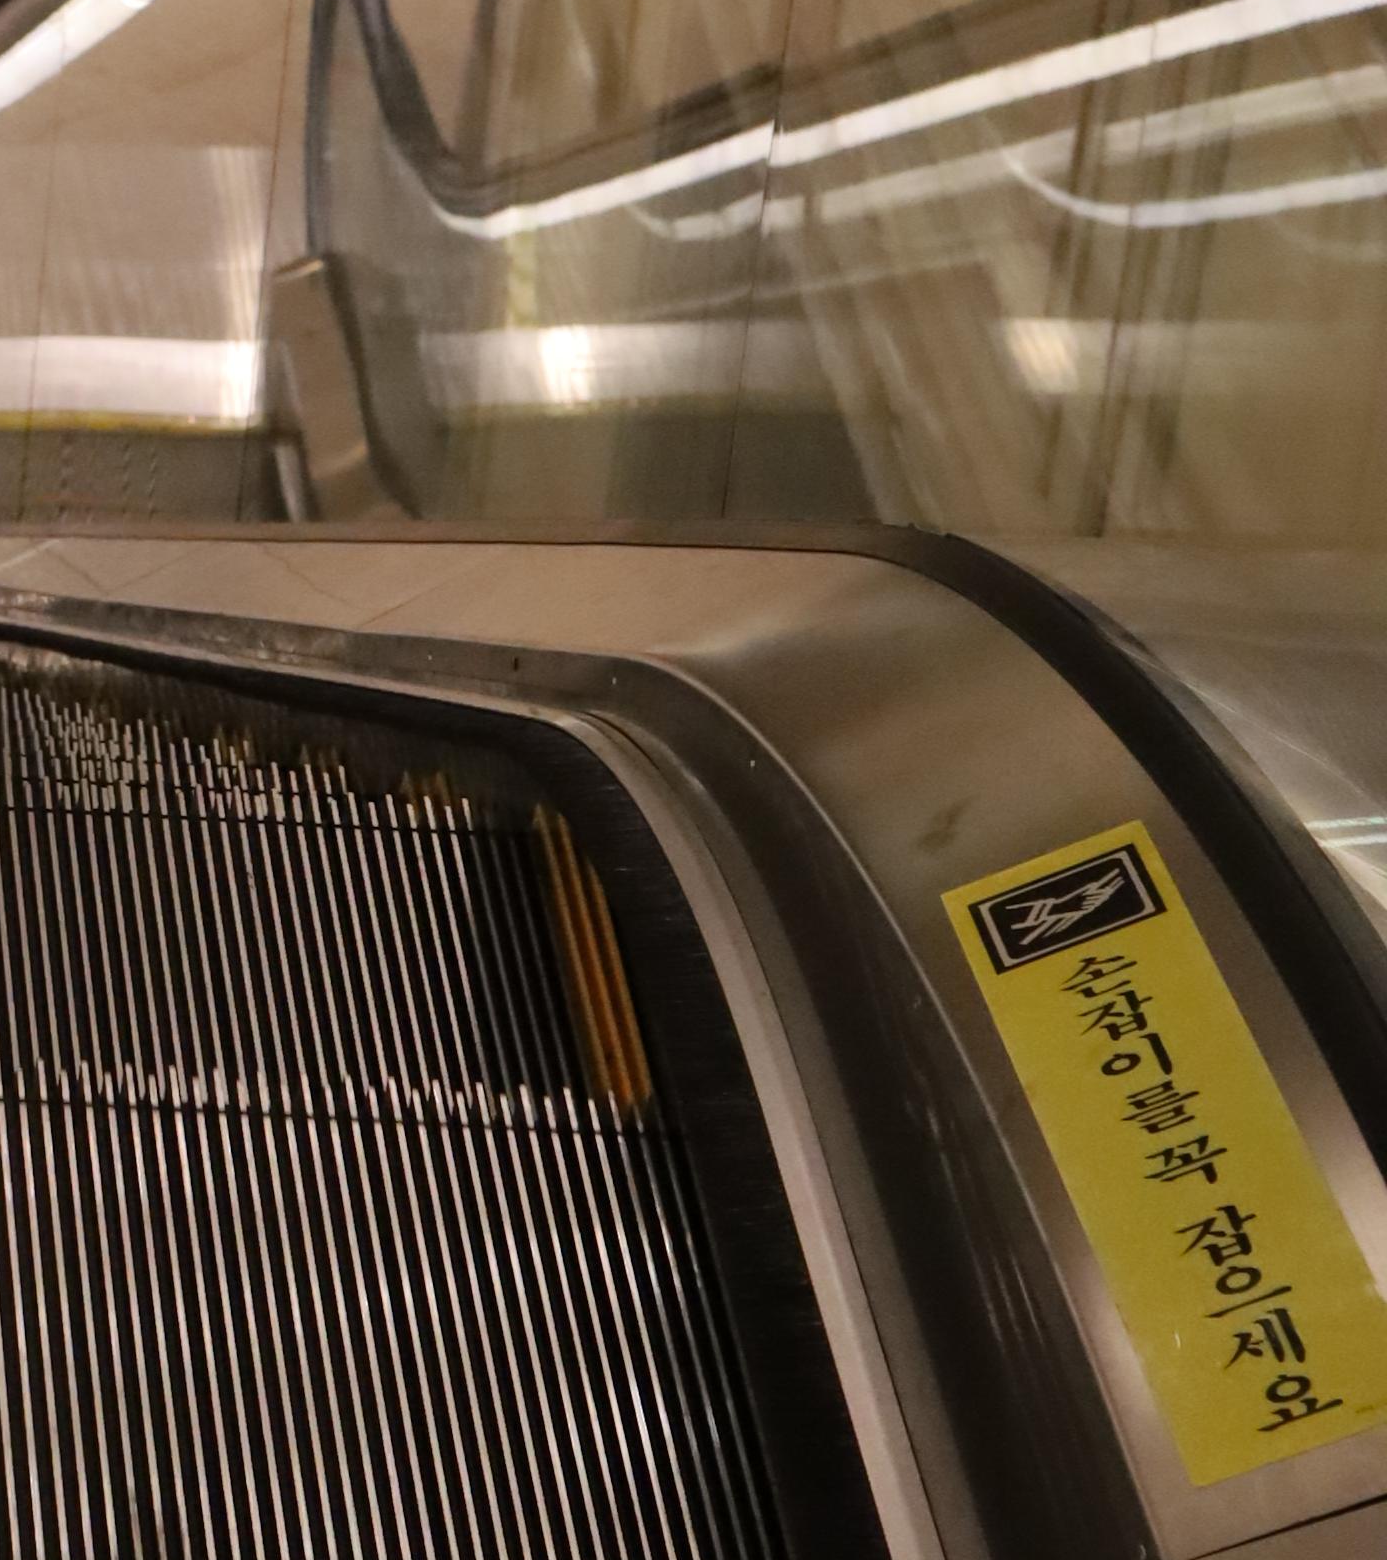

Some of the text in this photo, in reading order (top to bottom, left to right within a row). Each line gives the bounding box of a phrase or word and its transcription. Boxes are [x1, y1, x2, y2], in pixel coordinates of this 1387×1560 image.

[1061, 954, 1345, 1433] 손잡이를 꼭 잡으세요
